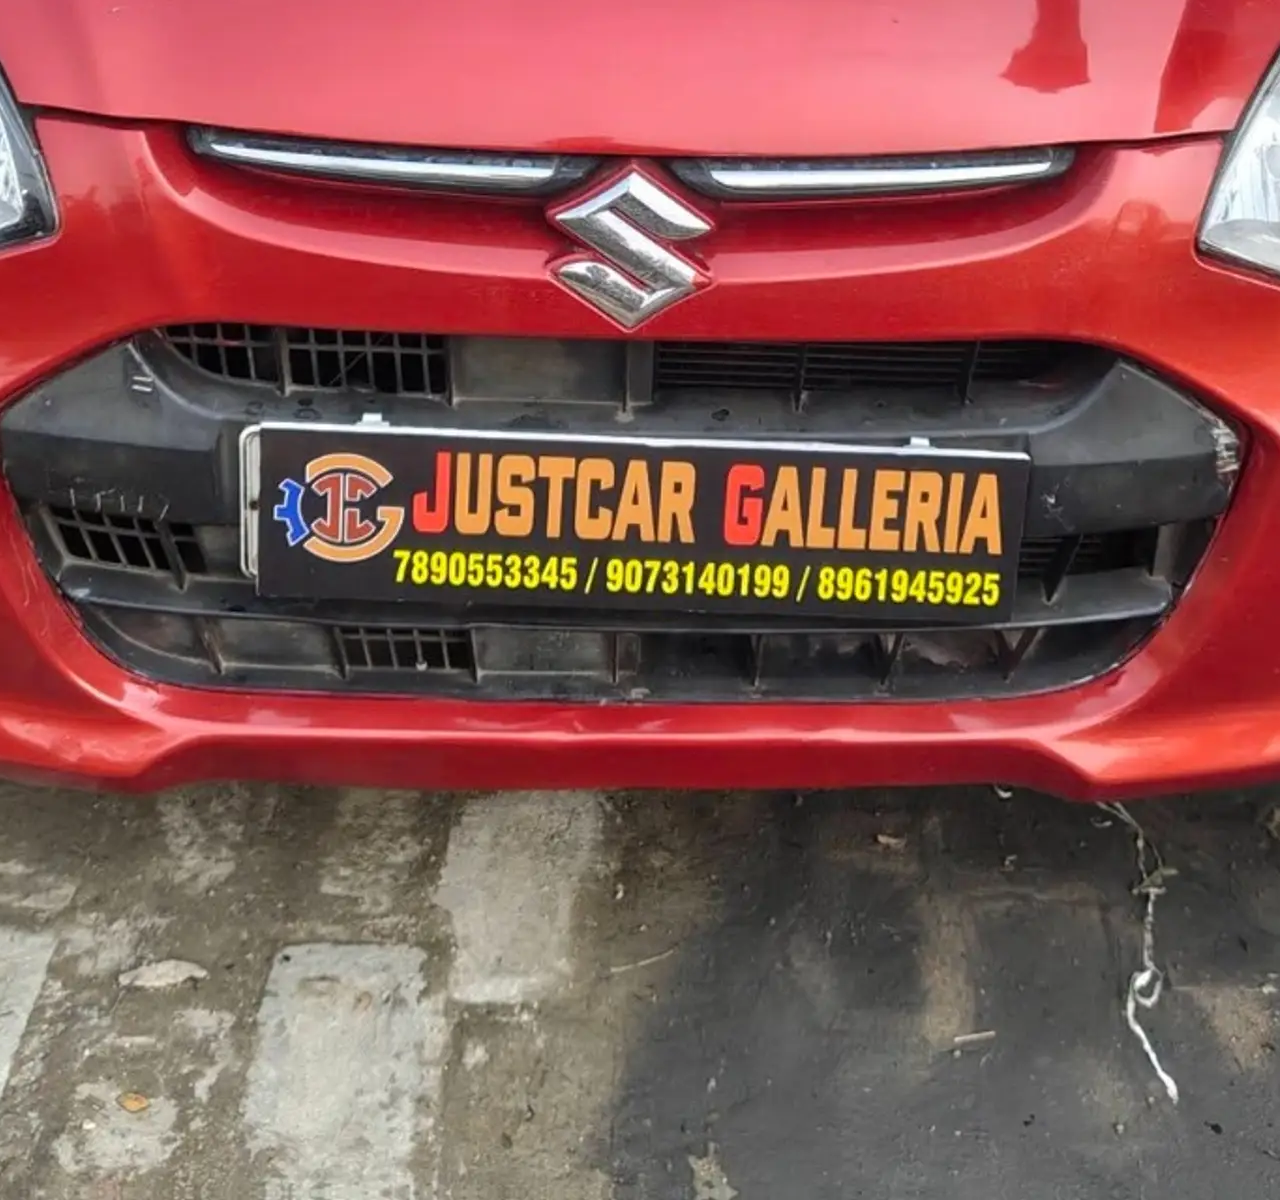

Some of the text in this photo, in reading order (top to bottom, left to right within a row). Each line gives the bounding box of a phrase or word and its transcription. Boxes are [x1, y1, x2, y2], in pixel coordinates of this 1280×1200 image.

[412, 451, 1004, 556] JUSTCAR GALLERIA
[393, 550, 1001, 607] 7890553345 / 9073140199 / 8961945925
